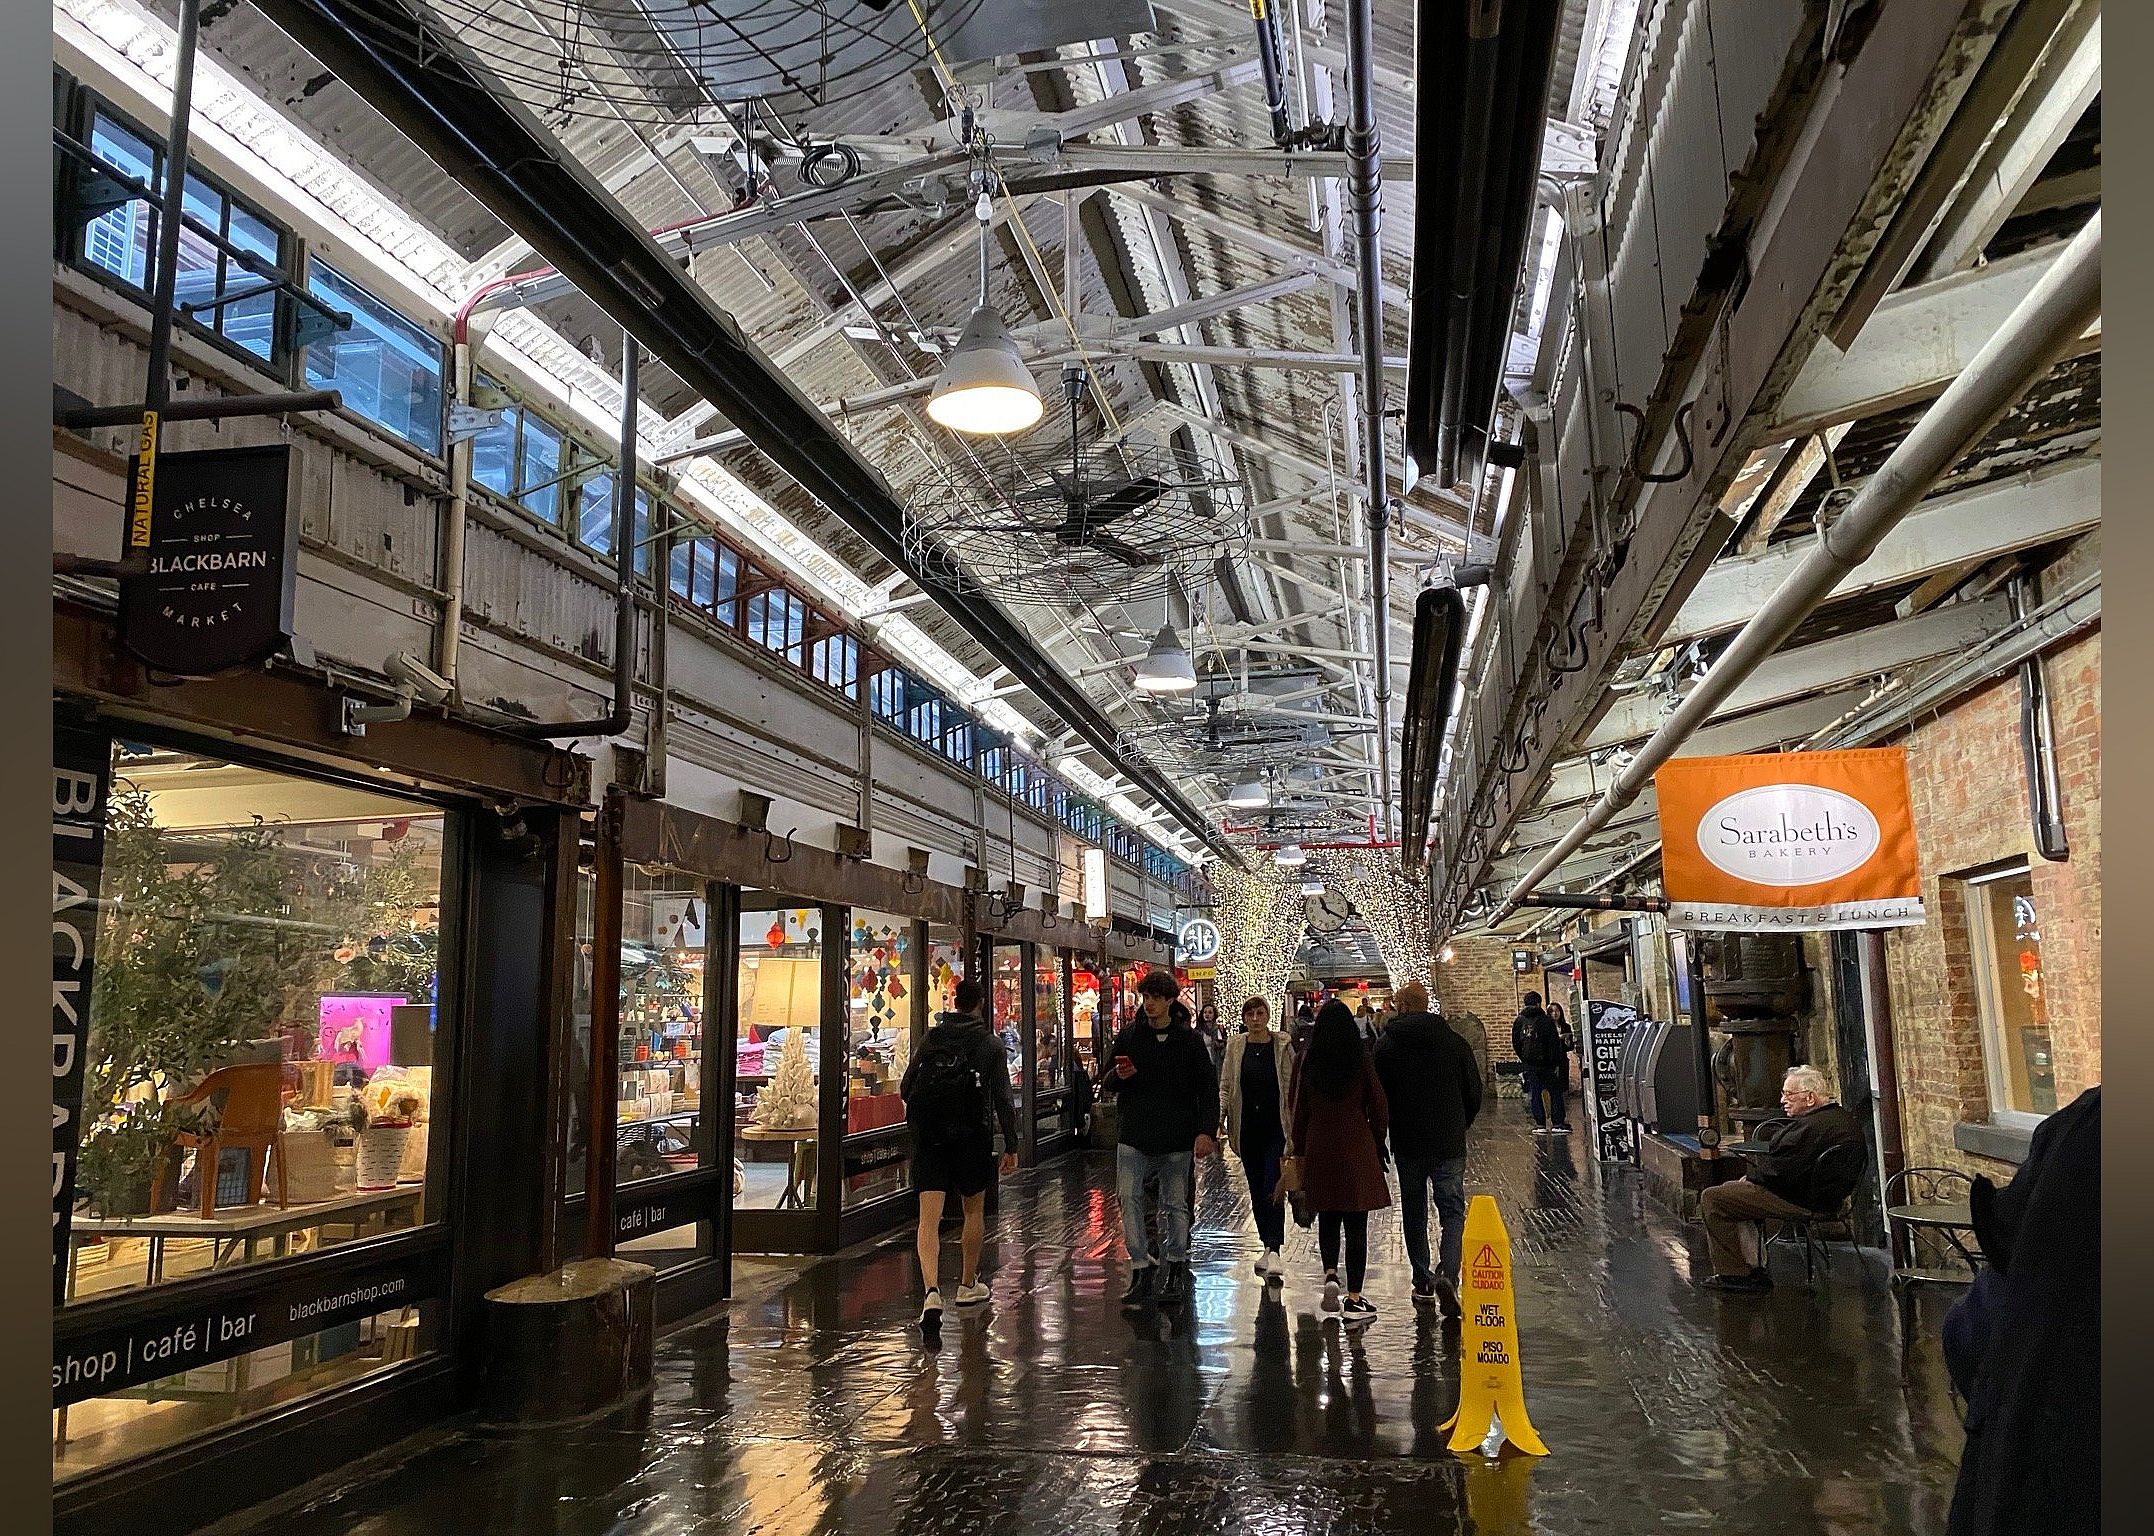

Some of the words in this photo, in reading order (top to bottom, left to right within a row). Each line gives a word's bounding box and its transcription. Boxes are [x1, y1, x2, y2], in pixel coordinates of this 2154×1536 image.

[141, 413, 154, 452] GAS
[133, 457, 151, 543] NATURAL
[173, 497, 252, 520] CHELSEA
[193, 533, 220, 543] SHOP
[150, 551, 267, 574] BLACKBARN
[190, 582, 217, 591] CAFE
[162, 602, 242, 628] MARKET
[1720, 810, 1858, 846] Sarabeth's
[1749, 846, 1832, 858] BAKERY
[1685, 910, 1810, 924] BREAKFAST
[1818, 913, 1827, 922] &
[1839, 907, 1909, 921] LUNCH
[53, 766, 97, 1264] BLACKB
[1596, 1046, 1621, 1059] GIF
[1597, 1060, 1617, 1072] CA
[620, 1209, 642, 1231] café
[651, 1206, 666, 1222] bar
[1472, 1270, 1505, 1280] CAUTION
[1472, 1280, 1505, 1290] CUIDADO
[289, 1278, 405, 1321] blackbarnshop.com
[1480, 1304, 1500, 1316] WET
[1475, 1315, 1505, 1327] FLOOR
[53, 1350, 117, 1388] shop
[143, 1323, 197, 1362] café
[220, 1313, 256, 1342] bar
[1482, 1341, 1503, 1353] PISO
[1477, 1352, 1509, 1364] MOJADO
